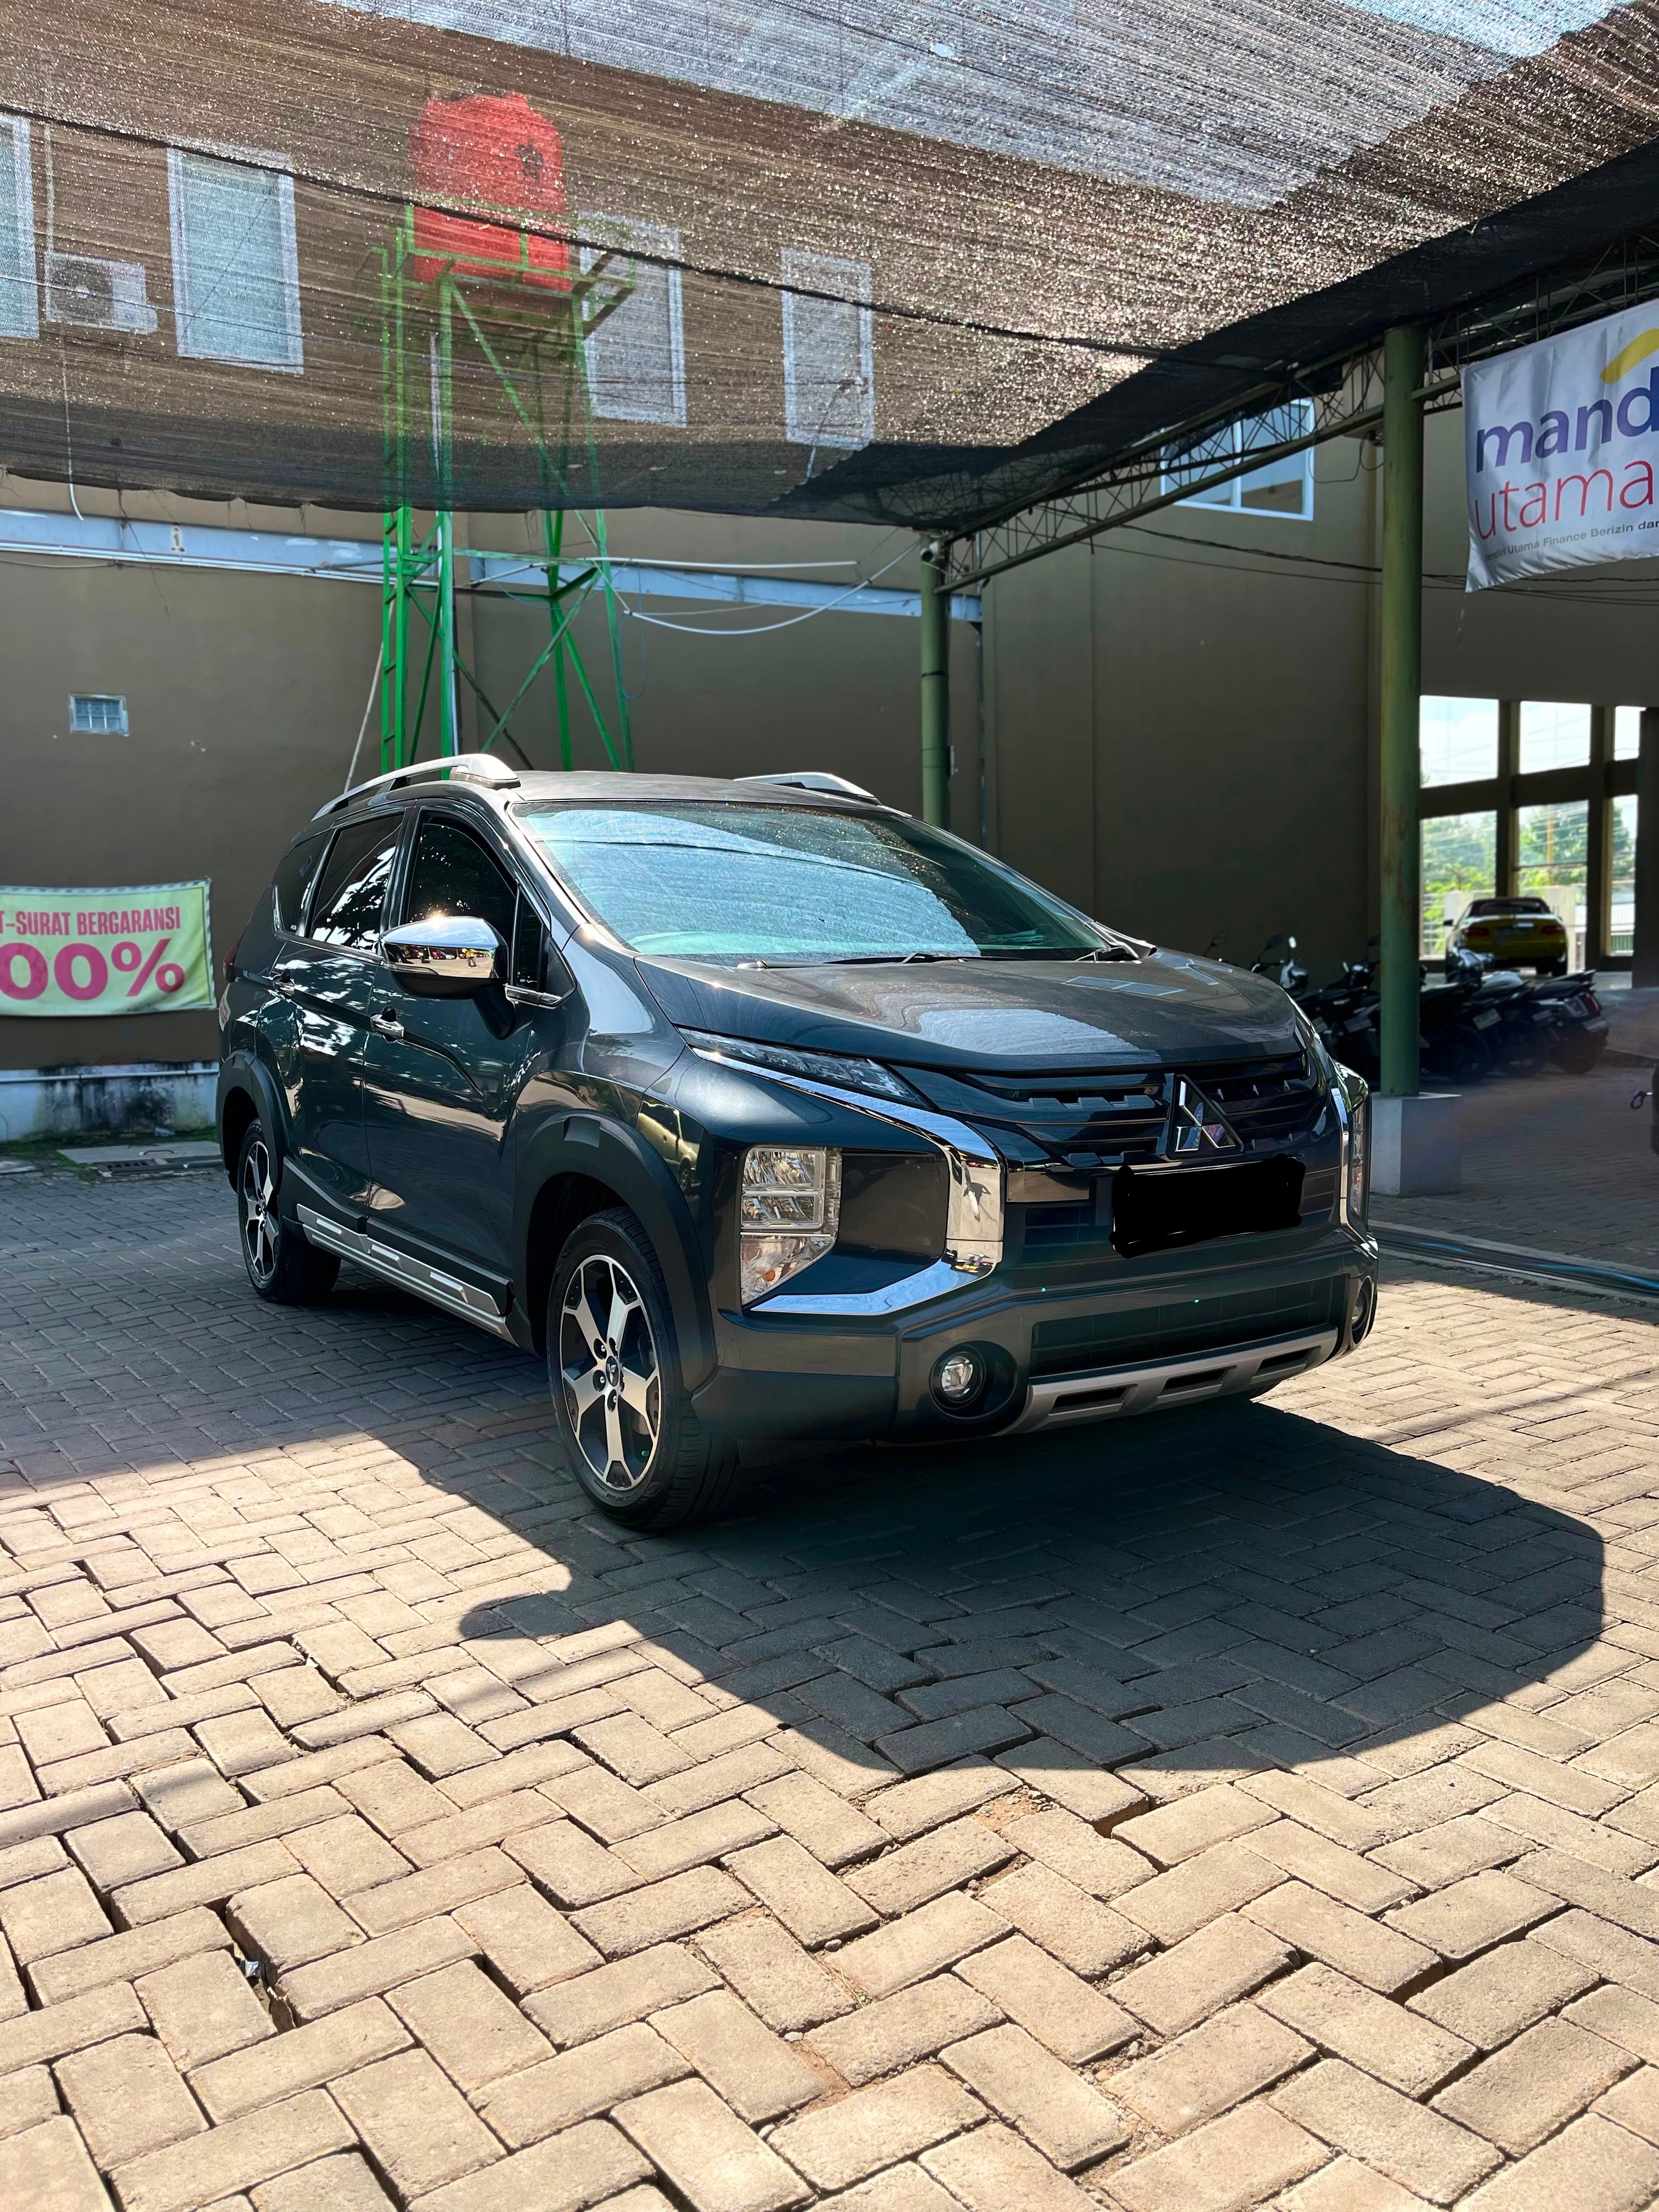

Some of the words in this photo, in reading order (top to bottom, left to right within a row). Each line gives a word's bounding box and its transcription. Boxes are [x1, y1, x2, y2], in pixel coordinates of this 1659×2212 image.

[1475, 460, 1654, 540] utama
[1508, 541, 1539, 554] Utama
[1543, 532, 1587, 547] Finance
[1591, 525, 1633, 538] Berizin
[77, 906, 180, 935] BERGARANSI
[0, 938, 185, 1001] 00%
